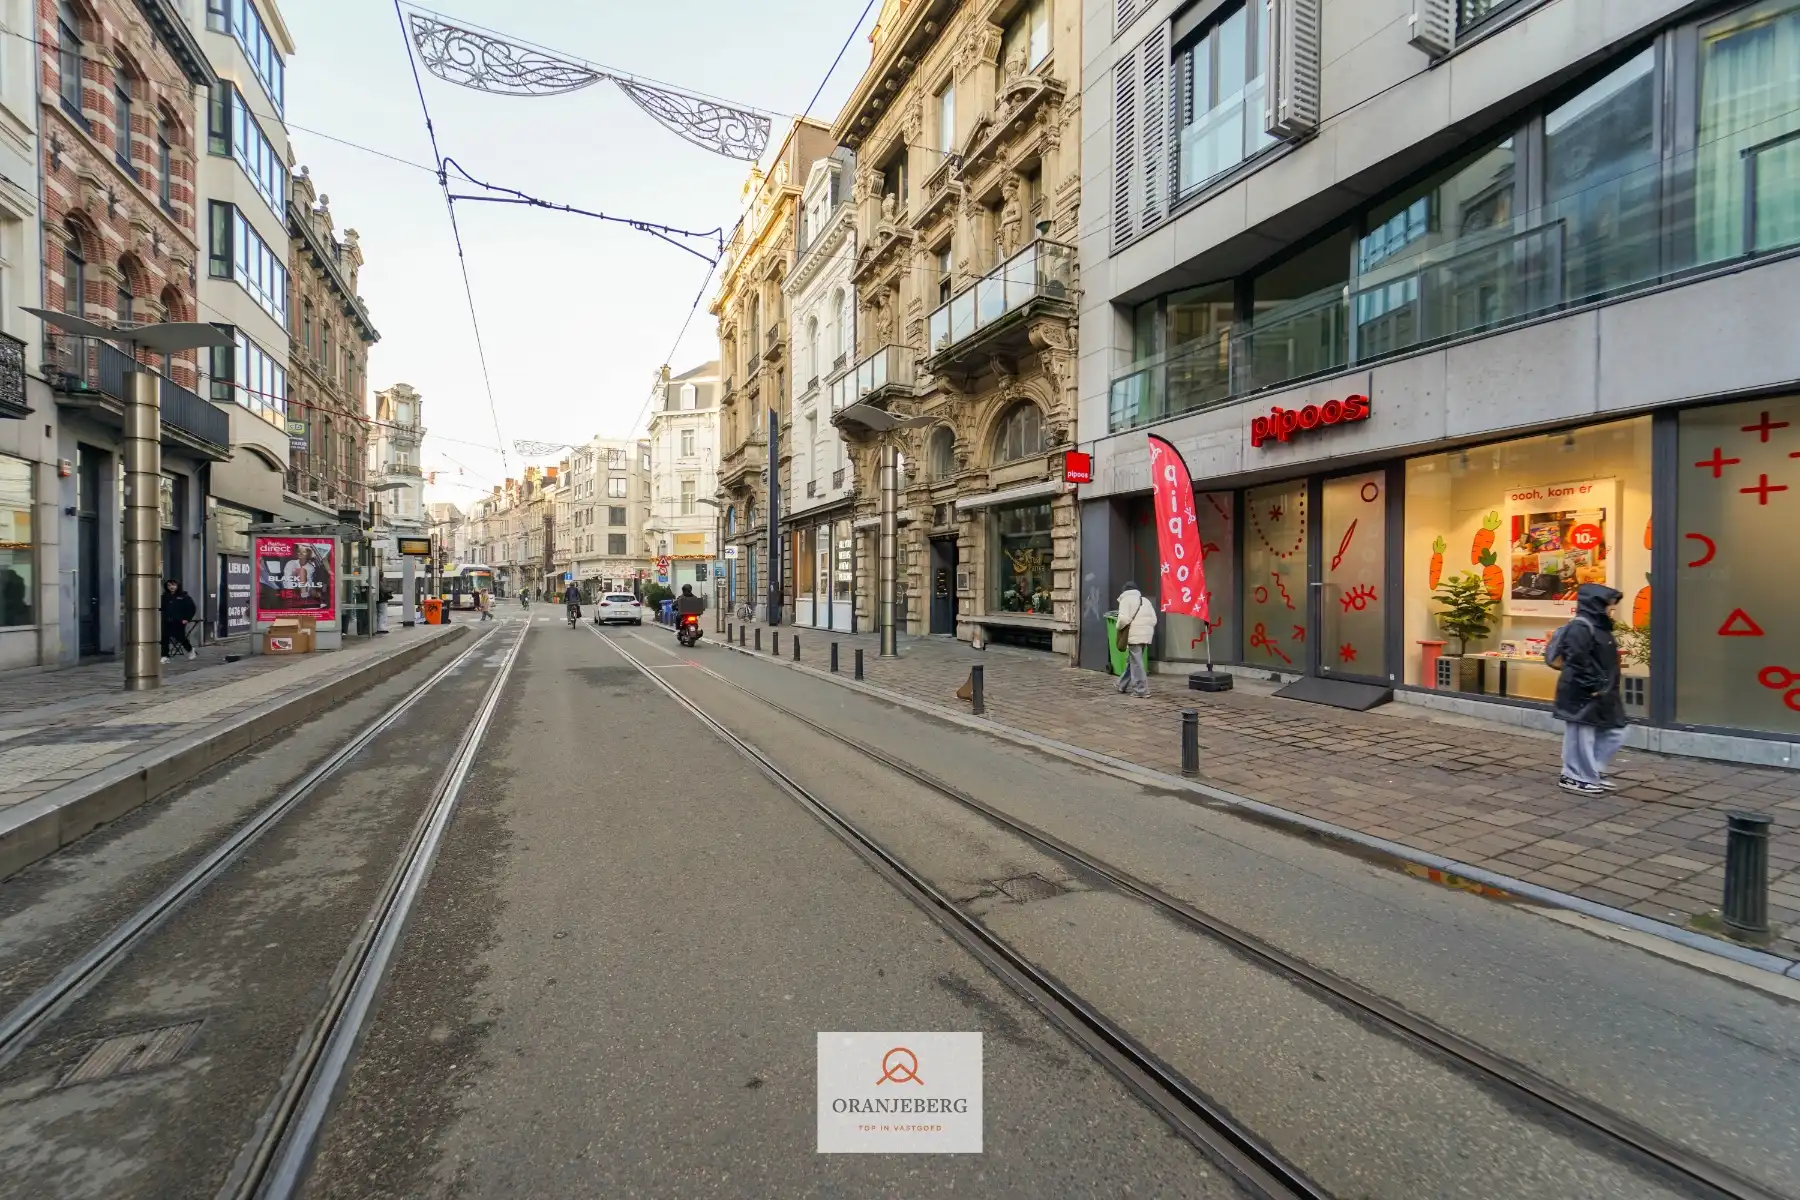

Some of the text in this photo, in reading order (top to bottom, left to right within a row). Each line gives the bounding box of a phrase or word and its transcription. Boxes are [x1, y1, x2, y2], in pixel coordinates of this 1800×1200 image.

[1252, 395, 1368, 447] pipoos
[1067, 469, 1089, 478] pipoos
[1512, 484, 1592, 501] oooh, kom er
